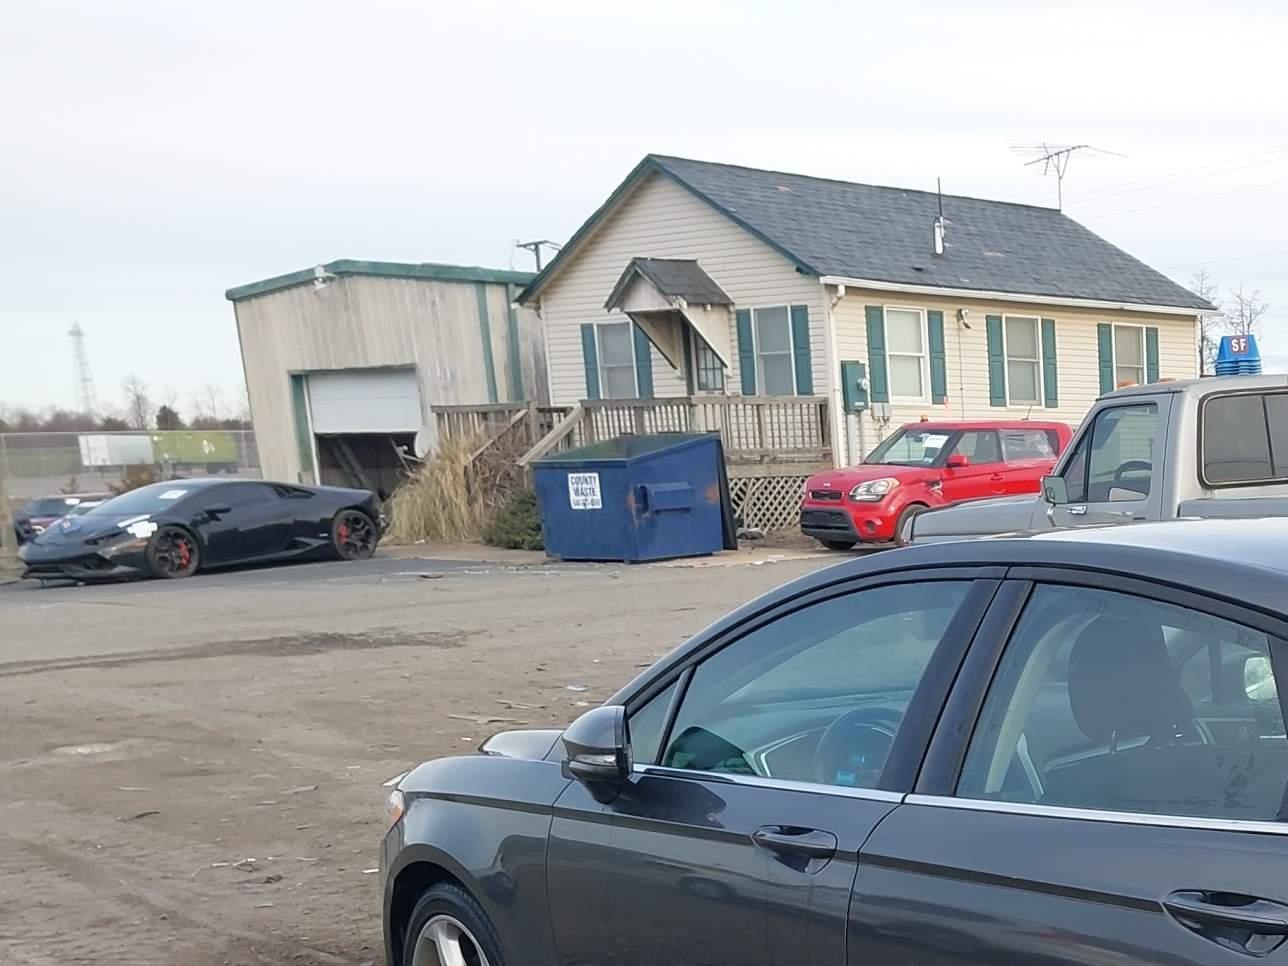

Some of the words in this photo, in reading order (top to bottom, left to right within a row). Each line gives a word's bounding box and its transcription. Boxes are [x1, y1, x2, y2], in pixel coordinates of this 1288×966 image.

[1231, 338, 1246, 352] SF
[571, 476, 597, 486] COUNTY
[573, 487, 597, 497] WASTE
